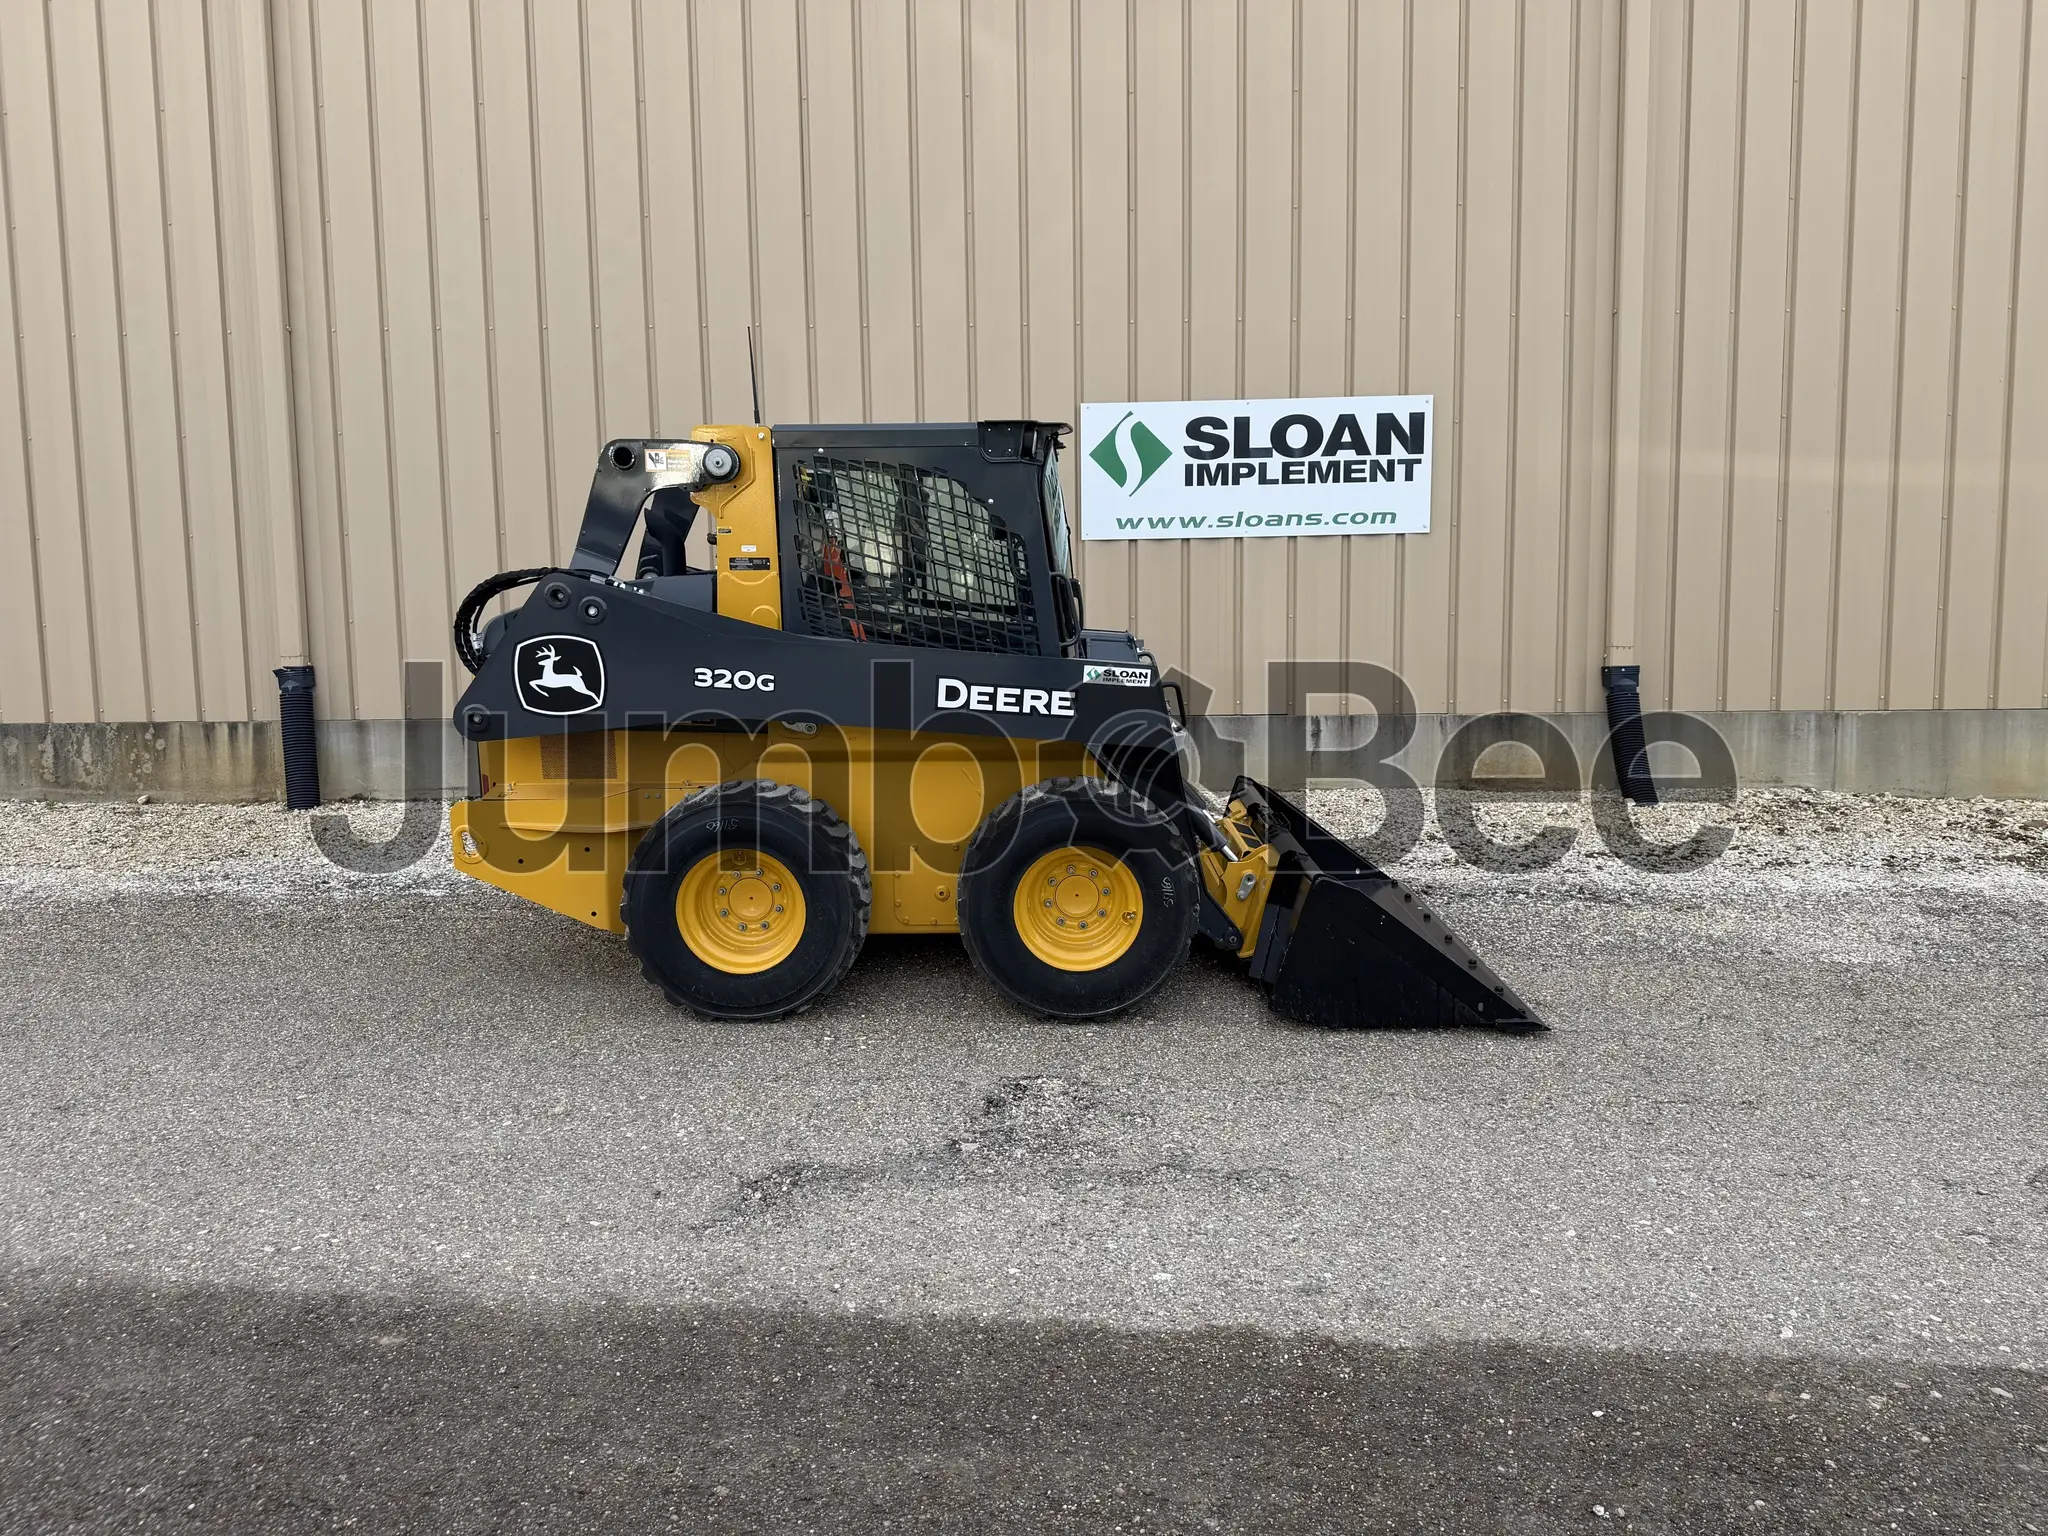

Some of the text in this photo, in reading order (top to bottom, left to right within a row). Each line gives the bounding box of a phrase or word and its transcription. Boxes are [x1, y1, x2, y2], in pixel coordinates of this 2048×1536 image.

[1183, 412, 1425, 460] SLOAN
[1184, 458, 1422, 487] IMPLEMENT
[1116, 511, 1397, 530] www.sloans.com
[694, 667, 775, 692] 320G
[1102, 677, 1147, 685] IMPLEMENT
[1103, 669, 1148, 680] SLOAN
[937, 678, 1076, 716] DEERE
